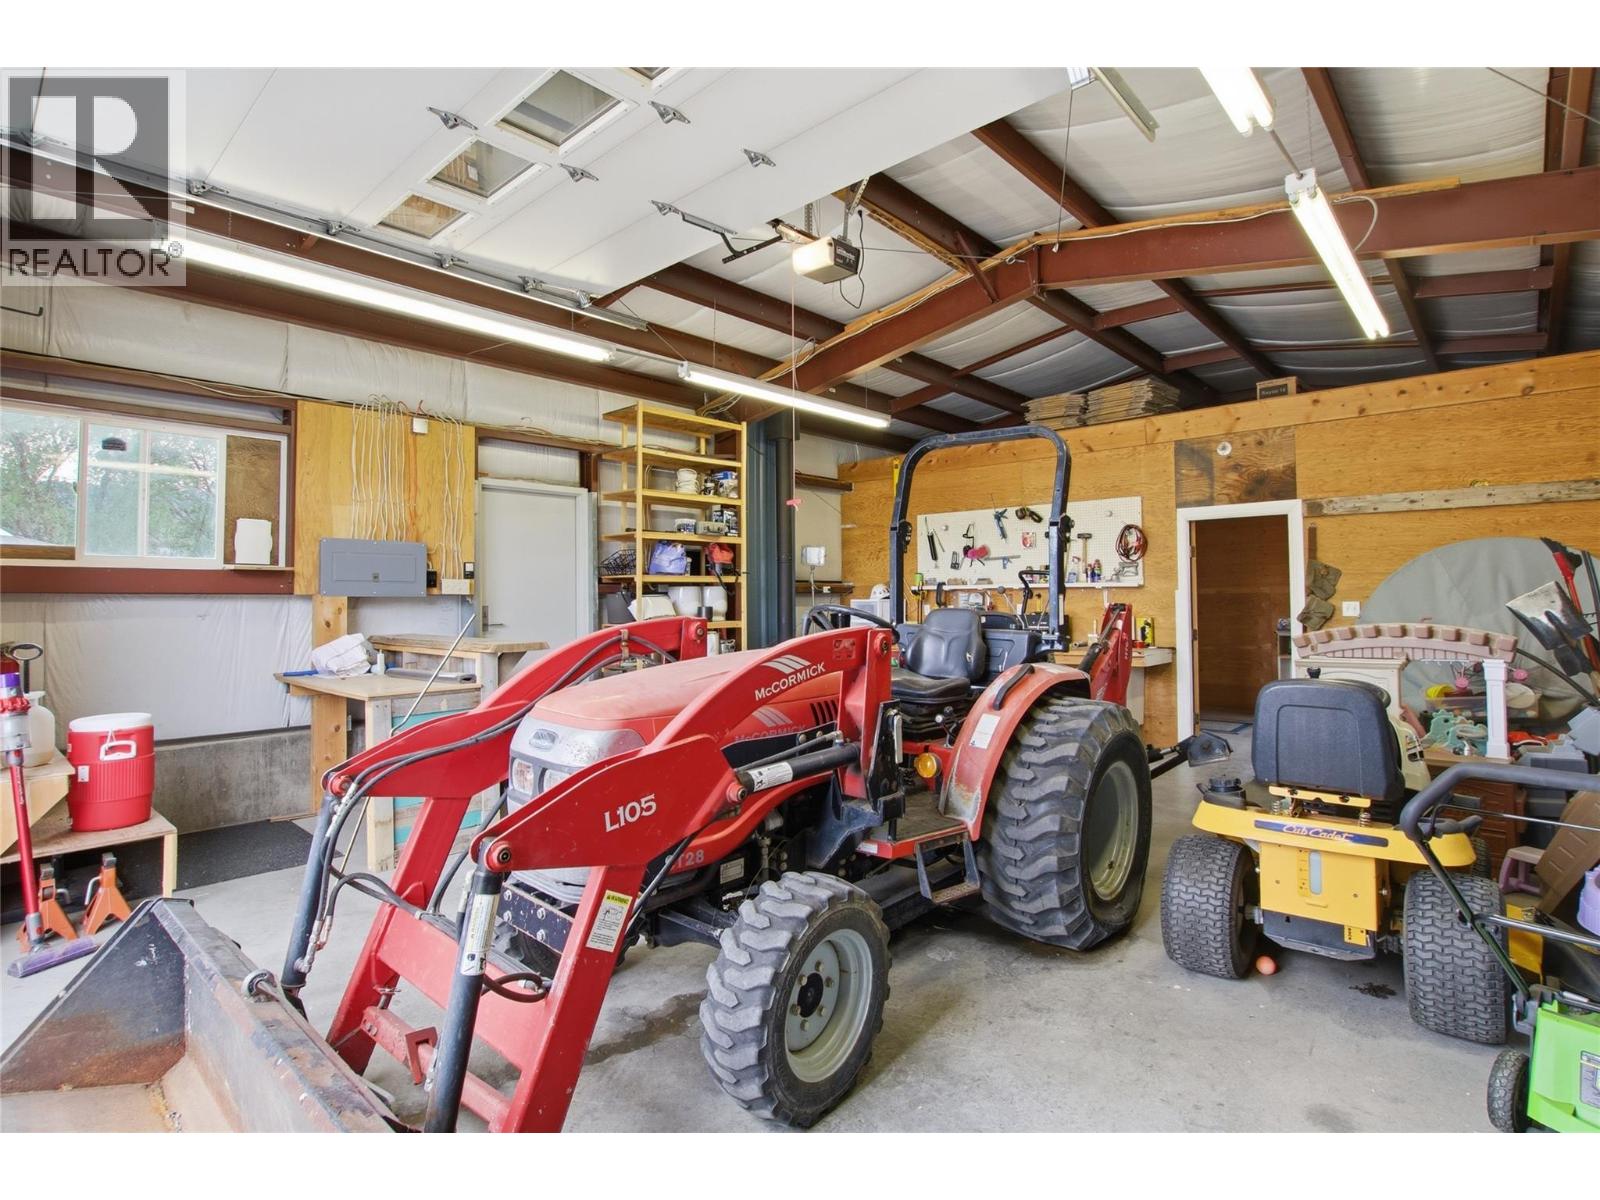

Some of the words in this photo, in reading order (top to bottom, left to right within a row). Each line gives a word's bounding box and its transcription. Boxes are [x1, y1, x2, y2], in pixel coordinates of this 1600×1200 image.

[754, 662, 826, 700] McCORMICK
[603, 793, 657, 832] L105
[1282, 823, 1308, 835] Cub
[1308, 828, 1355, 841] Cadet
